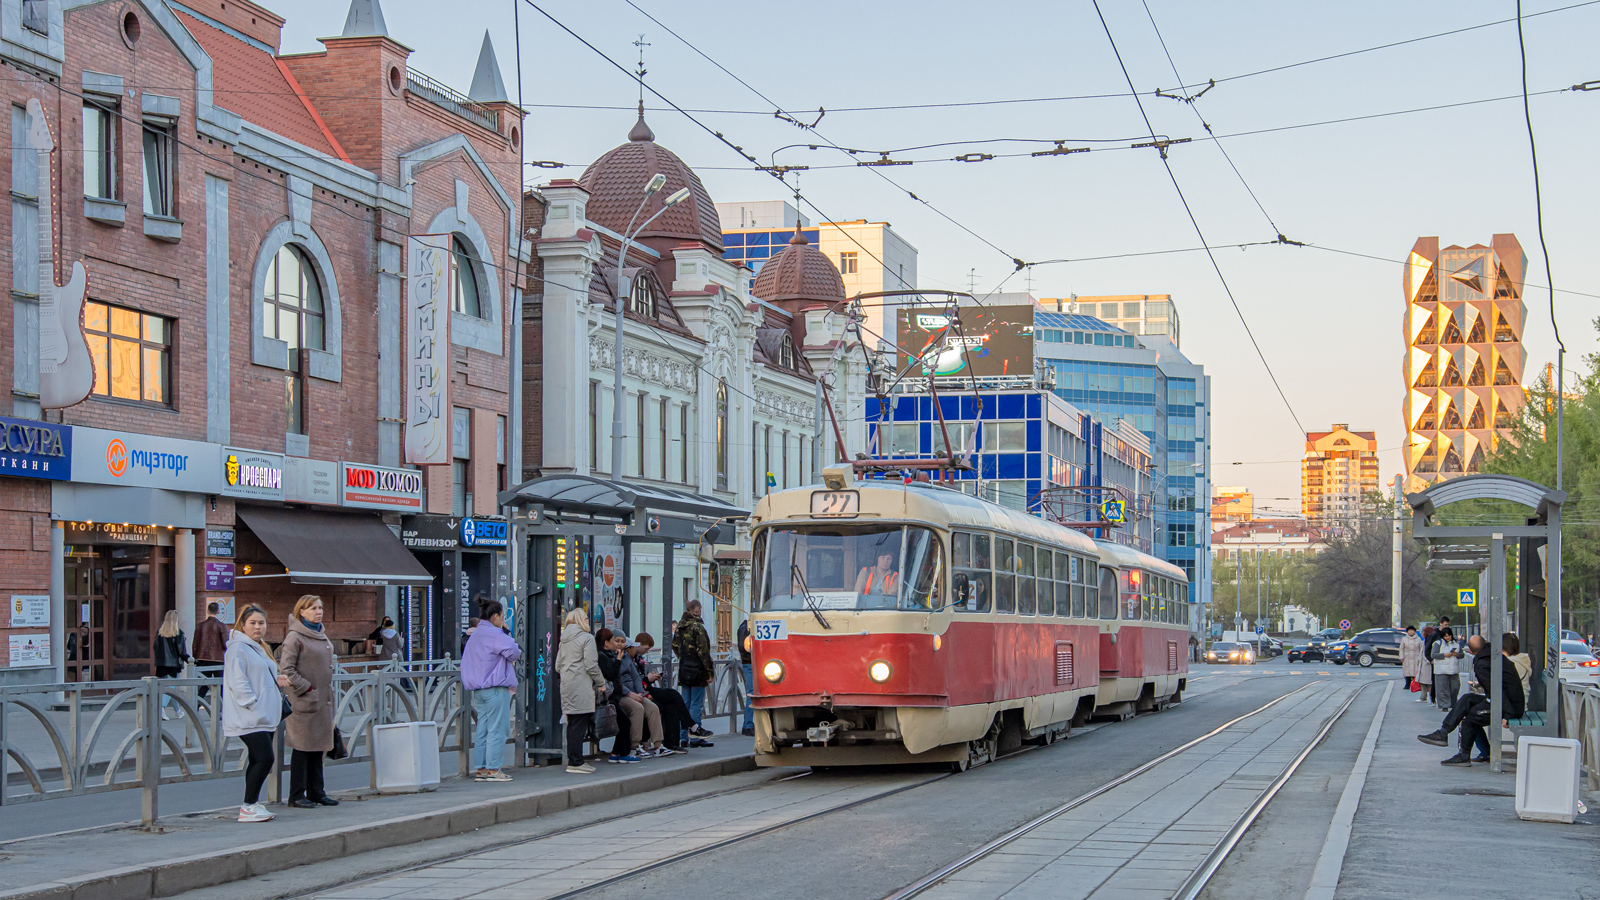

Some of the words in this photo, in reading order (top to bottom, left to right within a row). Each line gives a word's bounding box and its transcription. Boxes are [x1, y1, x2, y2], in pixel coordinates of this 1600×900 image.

[1, 457, 49, 471] ткани
[240, 464, 282, 489] КРОССПАРК
[345, 467, 376, 489] MOD
[377, 470, 420, 493] KOMOD
[822, 493, 851, 516] 27
[402, 538, 458, 548] ТЕЛЕВИЗОР
[756, 624, 780, 640] 537
